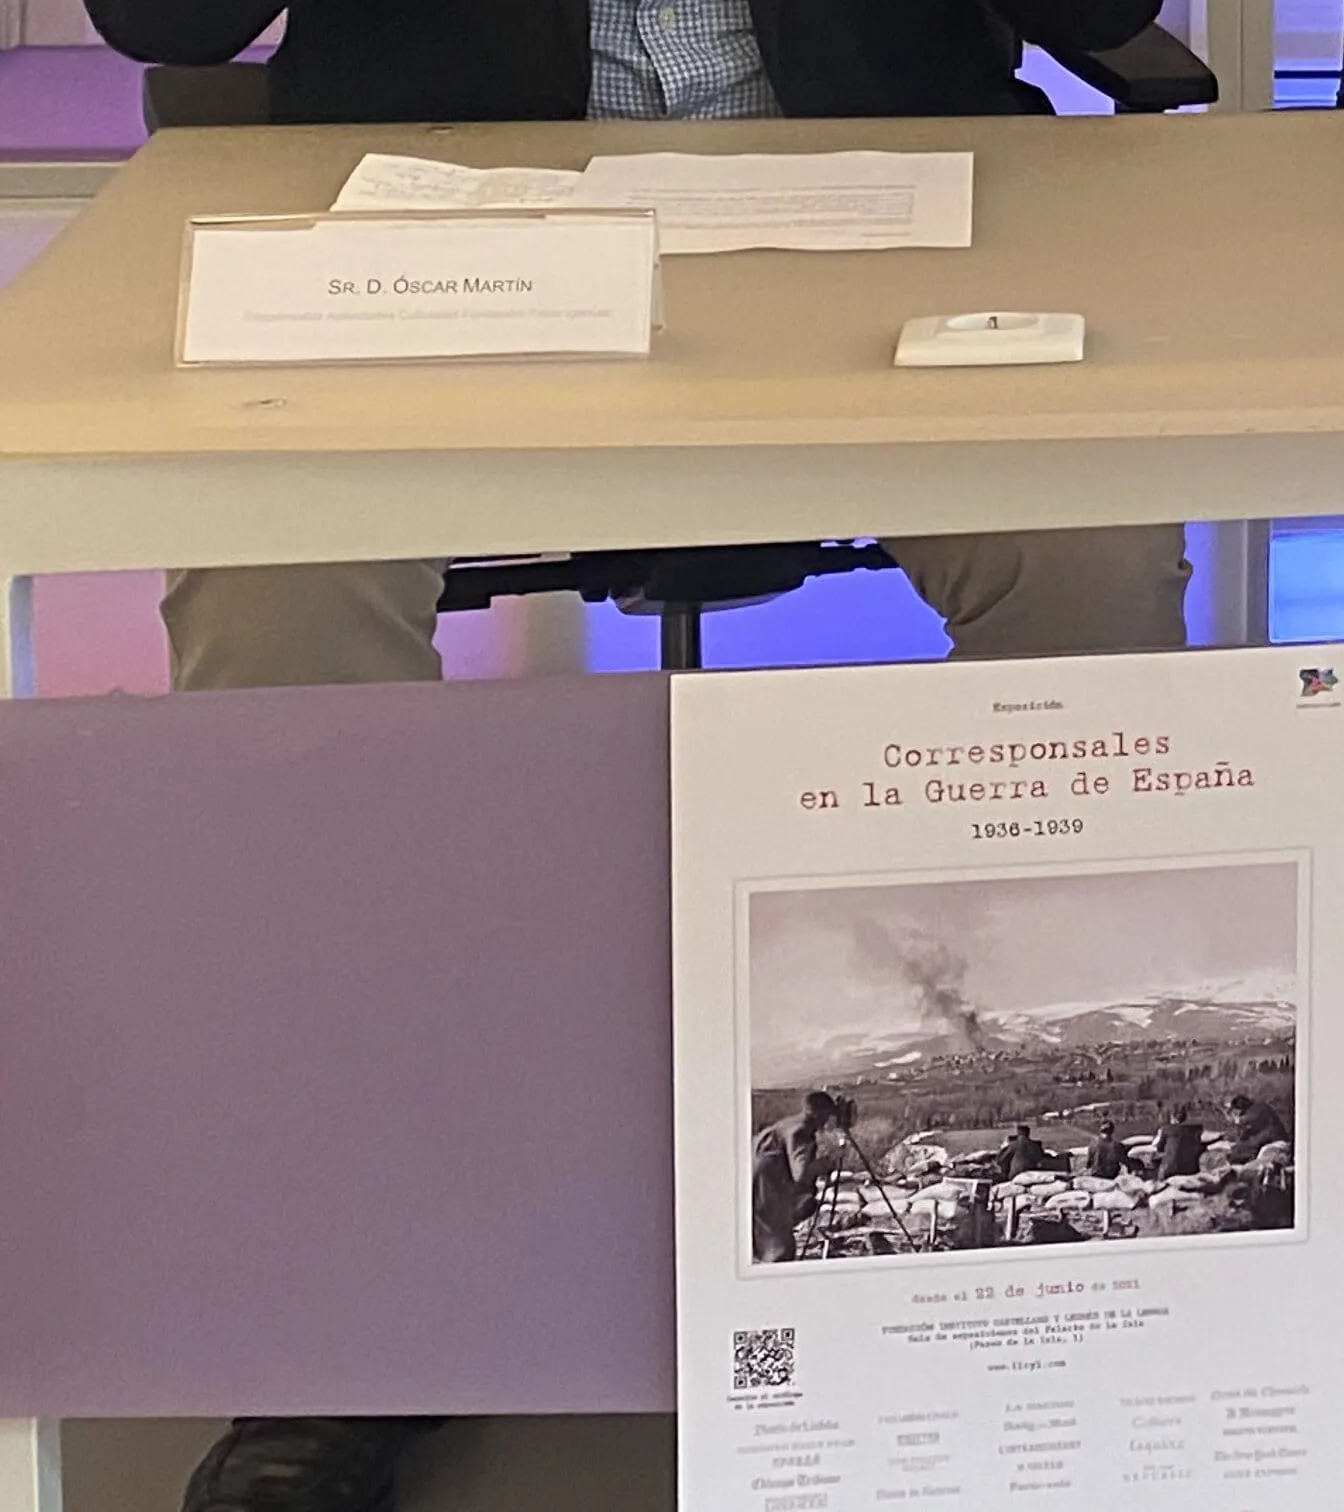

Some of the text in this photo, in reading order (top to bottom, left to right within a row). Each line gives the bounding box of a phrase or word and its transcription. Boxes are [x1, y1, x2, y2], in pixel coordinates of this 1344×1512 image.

[393, 274, 457, 294] ÓSCAR
[463, 276, 533, 294] MARTÍN
[883, 731, 1171, 770] Corresponsales
[799, 759, 1256, 811] en la Guerra de España
[971, 816, 1084, 841] 1936-1939
[974, 1286, 995, 1299] 22
[1005, 1284, 1024, 1298] de
[1036, 1280, 1084, 1298] junio
